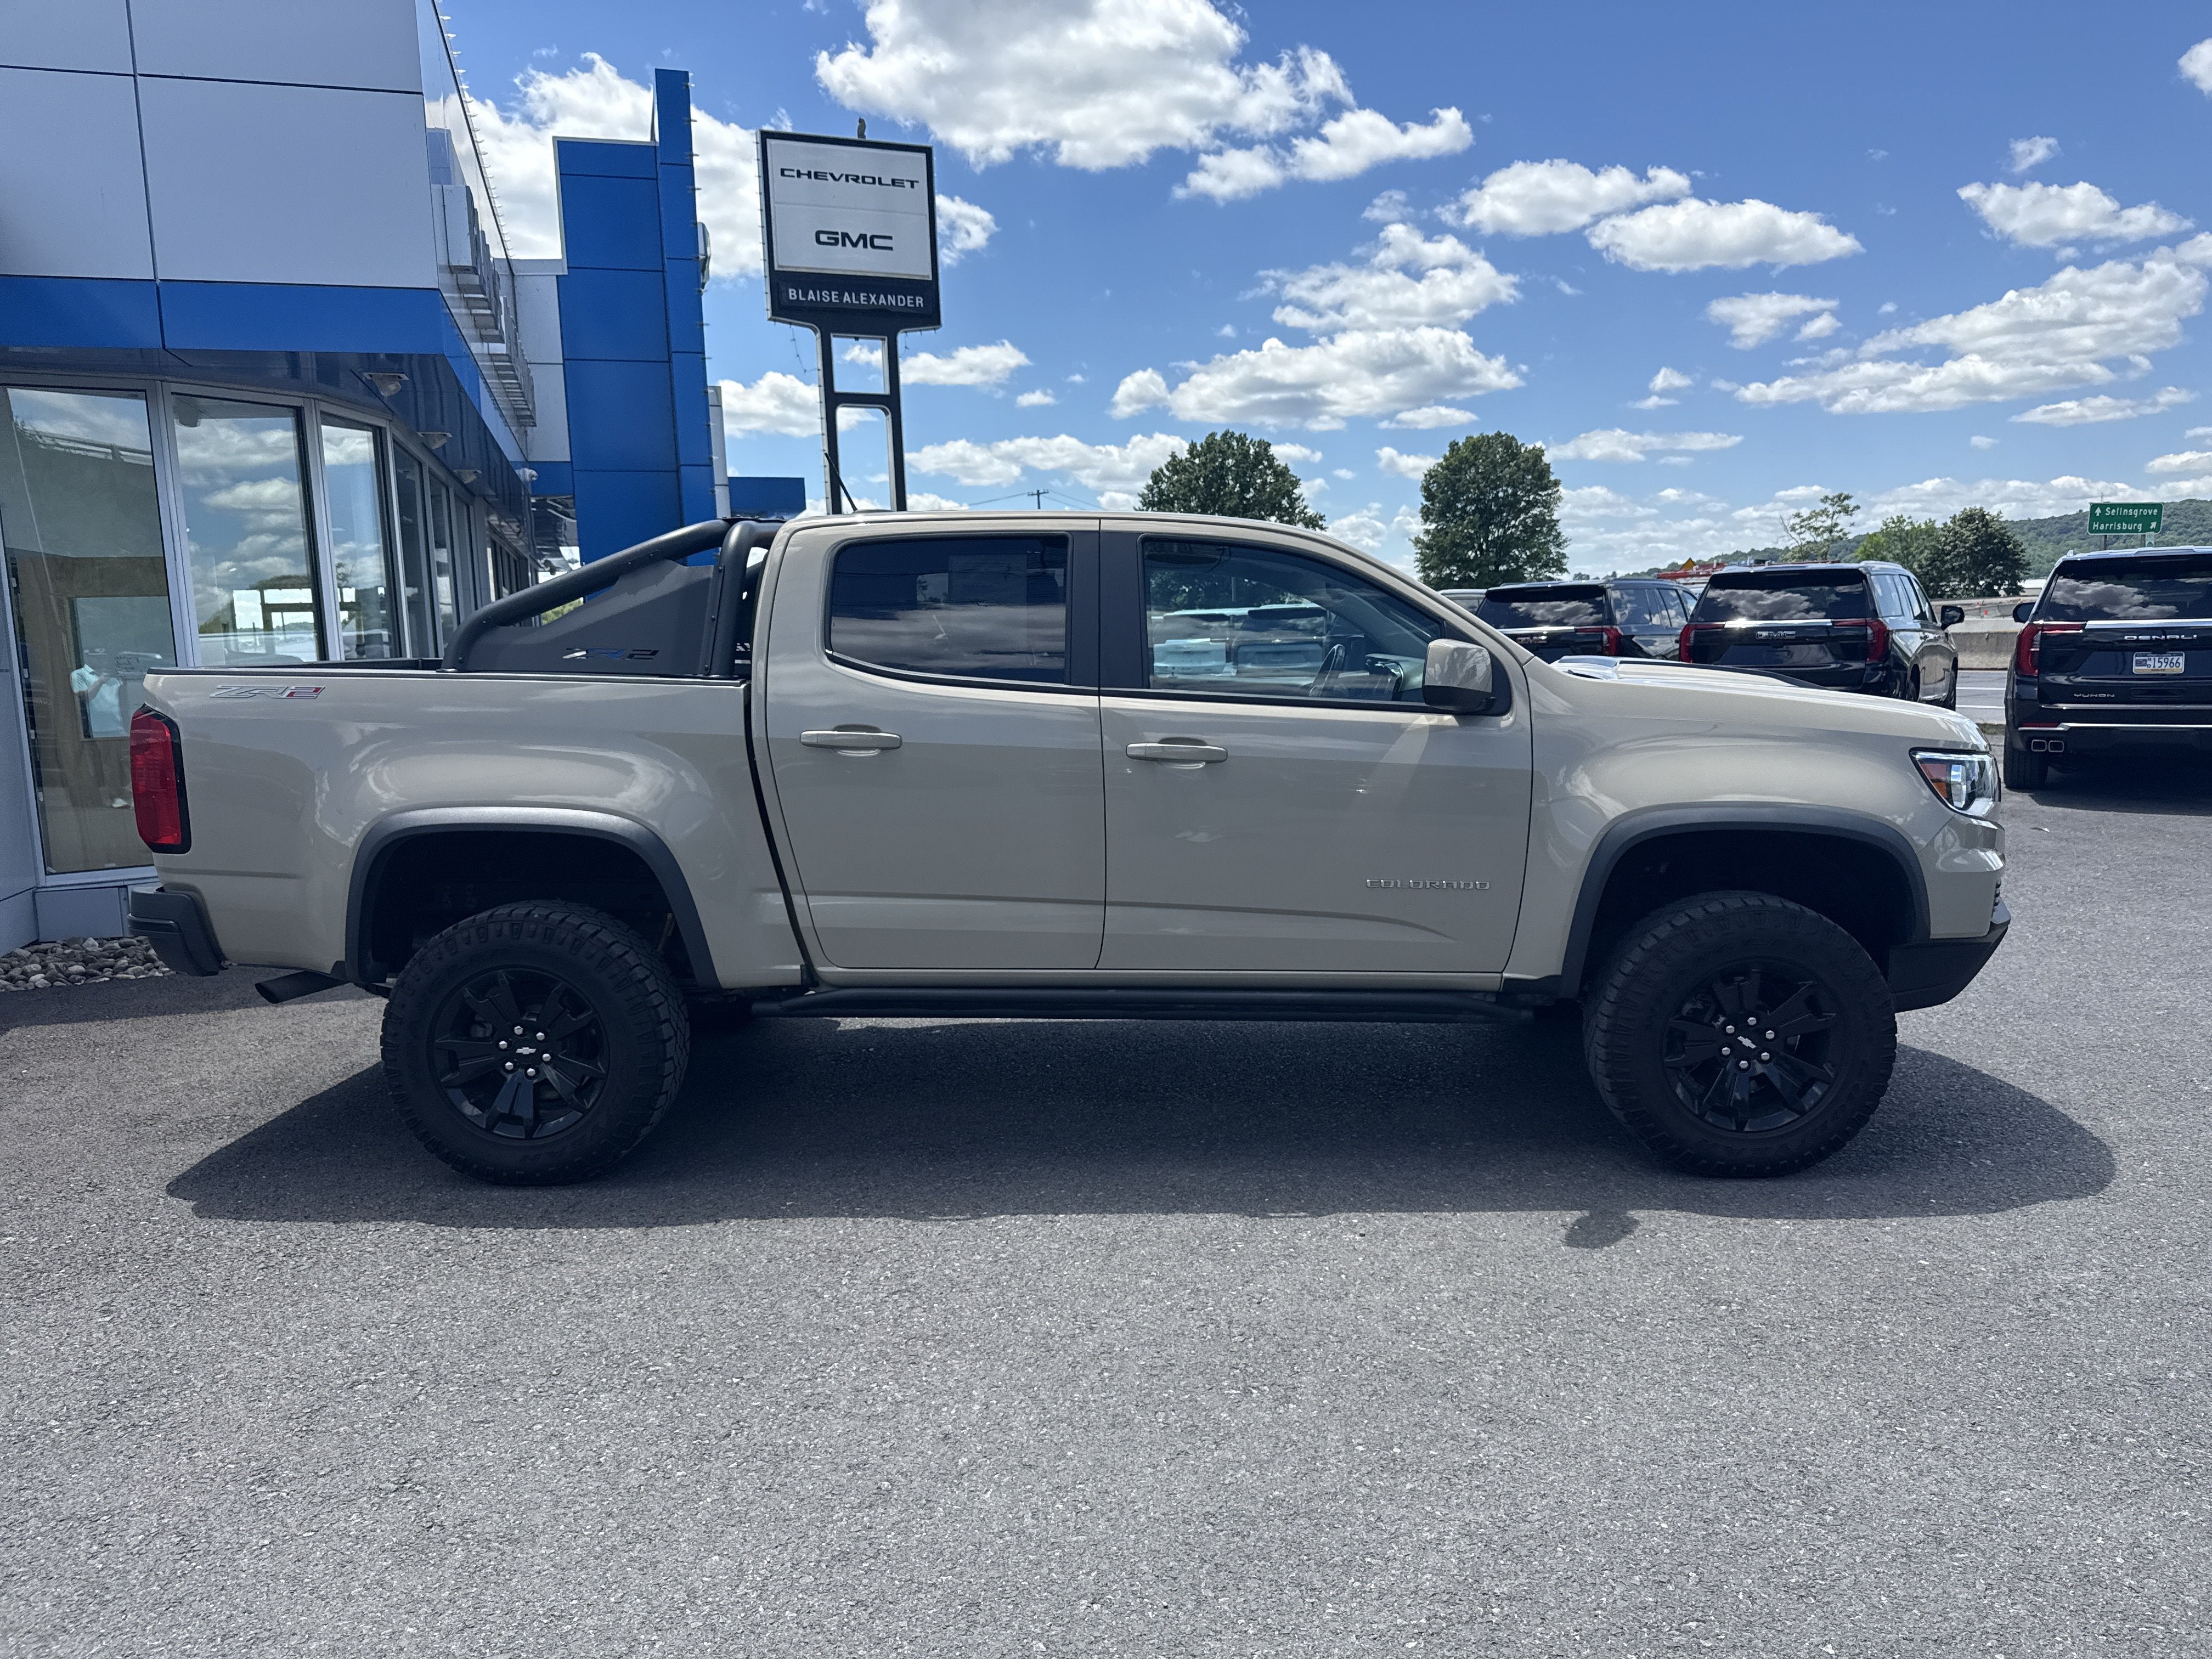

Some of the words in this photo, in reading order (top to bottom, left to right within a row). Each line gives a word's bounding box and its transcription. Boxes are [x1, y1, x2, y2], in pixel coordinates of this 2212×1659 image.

[780, 168, 919, 189] CHEVROLET
[815, 230, 893, 251] GMC
[788, 288, 839, 303] BLAISE
[843, 292, 924, 308] ALEXANDER
[2105, 507, 2158, 517] Selinsgrove
[2092, 522, 2142, 532] Harrisburg
[1756, 630, 1796, 639] GMC
[2152, 657, 2181, 668] 15966
[210, 686, 325, 699] ZR2
[1367, 879, 1490, 889] COLORADO
